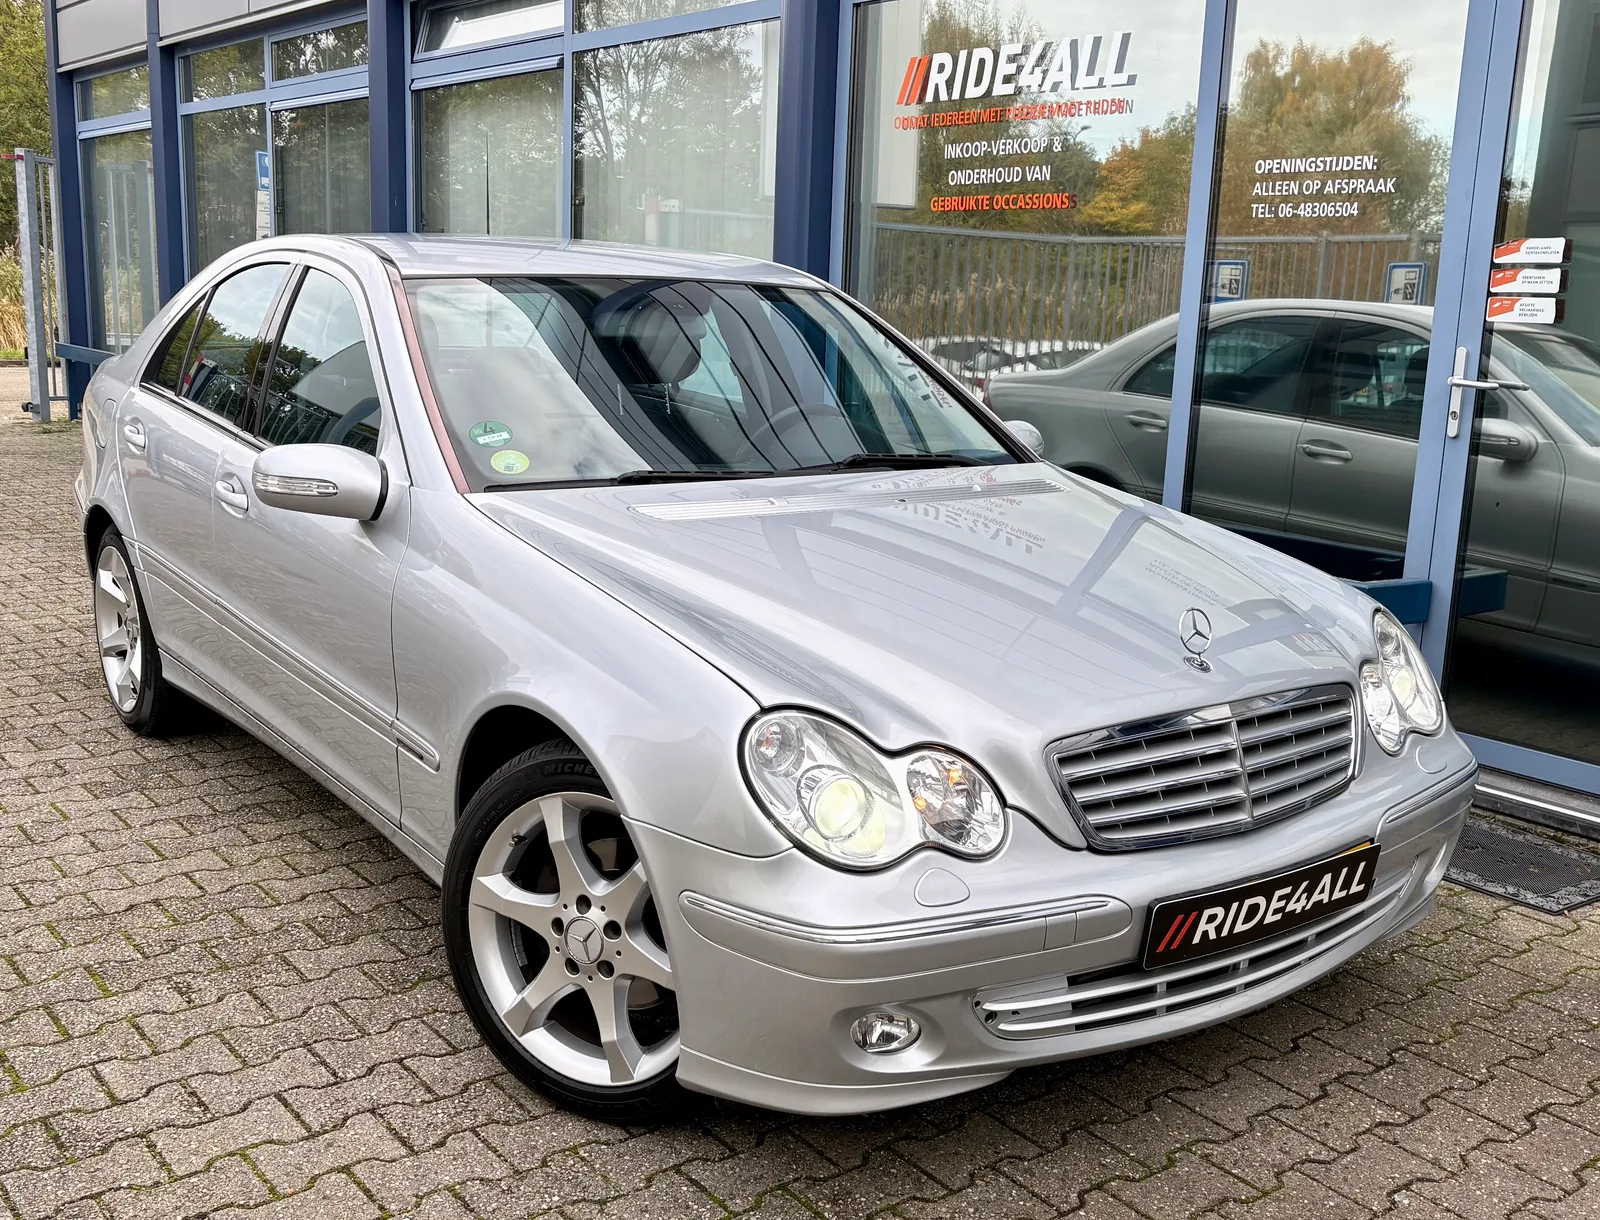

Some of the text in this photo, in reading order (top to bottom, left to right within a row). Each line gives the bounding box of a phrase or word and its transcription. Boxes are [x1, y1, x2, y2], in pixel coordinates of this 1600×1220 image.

[931, 110, 978, 128] IEDEREEN
[979, 107, 1002, 123] MET
[944, 136, 1062, 160] INKOOP-VERKOOP &
[1254, 155, 1378, 174] OPENINGSTIJDEN:
[948, 165, 1051, 186] ONDERHOUD VAN
[1252, 177, 1396, 196] ALLEEN OP AFSPRAAK
[930, 193, 1070, 212] GEBRUIKTE OCCASSIONS
[1250, 202, 1359, 218] TEL: 06-48306504
[483, 422, 496, 434] 4
[543, 763, 600, 776] MICHE
